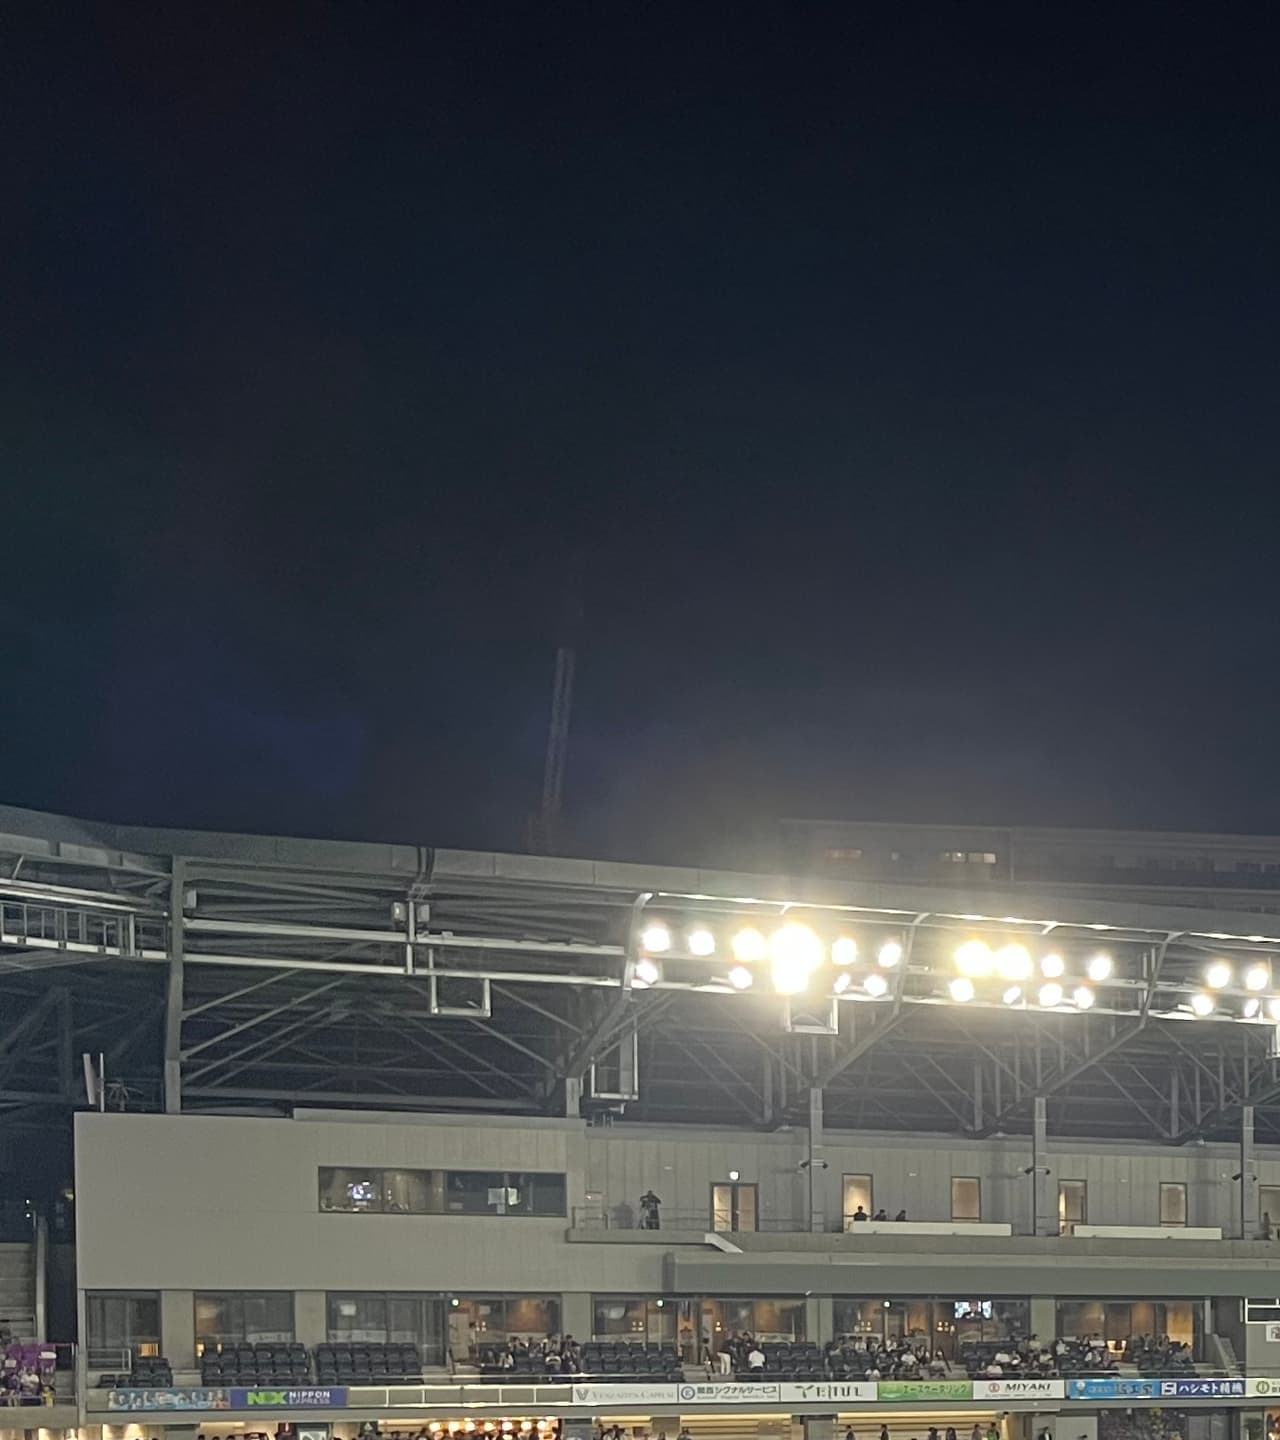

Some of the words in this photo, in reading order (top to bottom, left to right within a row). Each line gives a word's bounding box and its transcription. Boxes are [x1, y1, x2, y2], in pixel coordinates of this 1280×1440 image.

[903, 1384, 967, 1394] エースケータリング
[1005, 1383, 1051, 1391] MIYAKI
[1179, 1380, 1243, 1394] ハシモト精機
